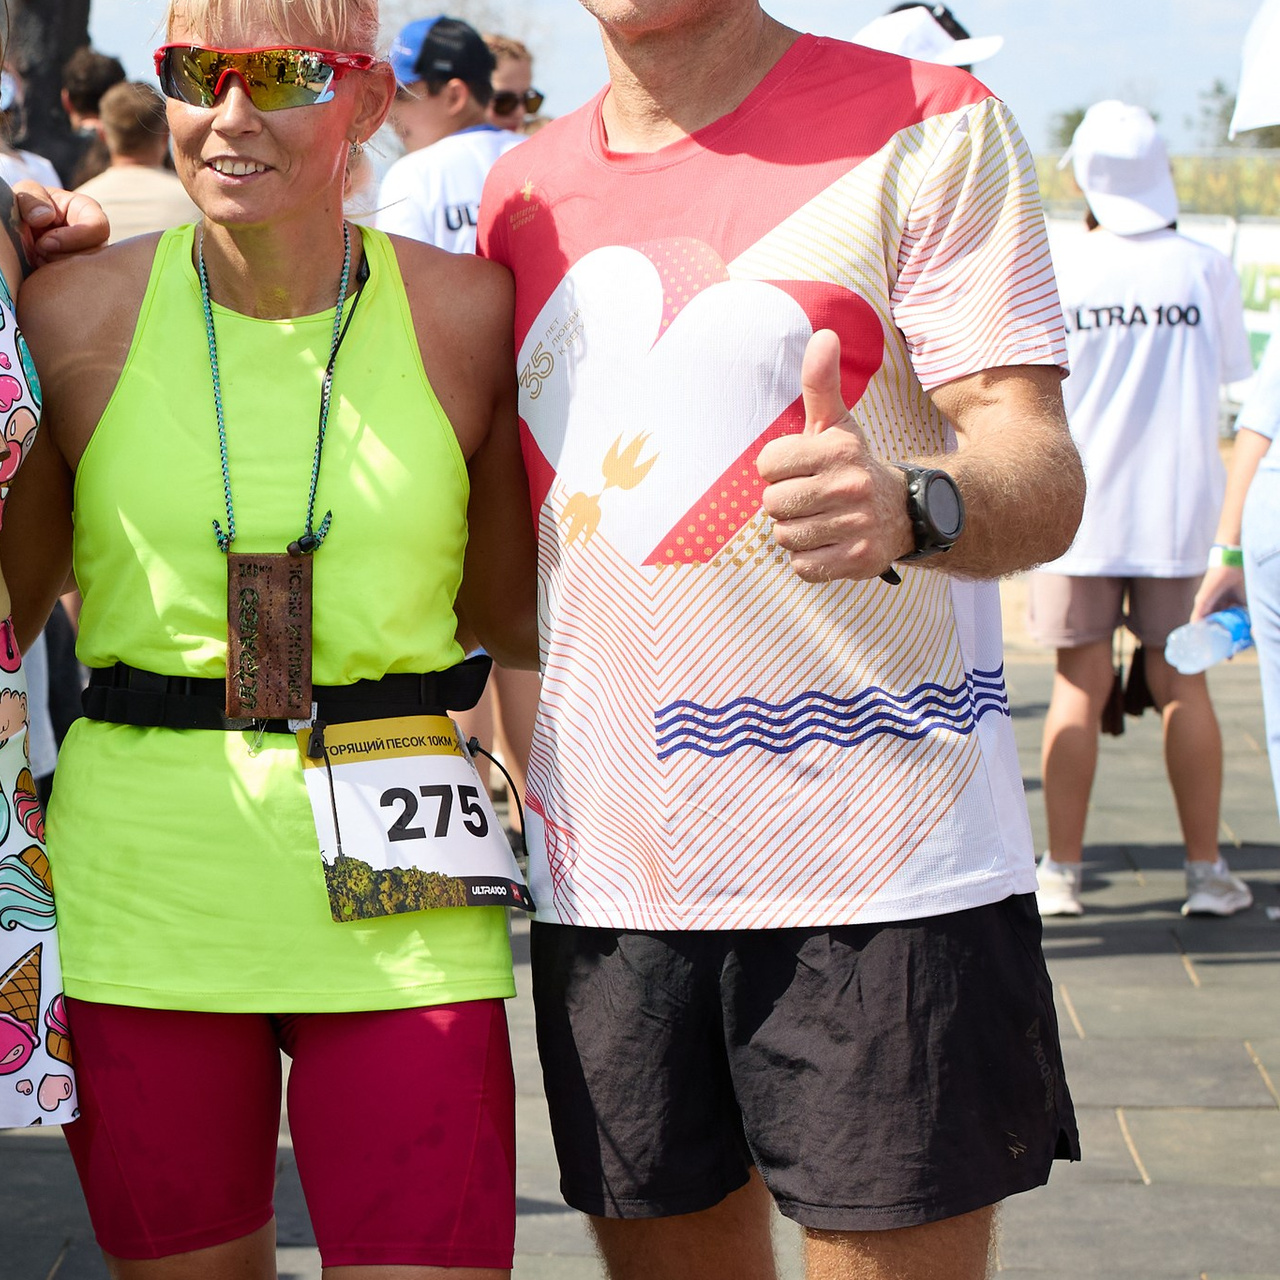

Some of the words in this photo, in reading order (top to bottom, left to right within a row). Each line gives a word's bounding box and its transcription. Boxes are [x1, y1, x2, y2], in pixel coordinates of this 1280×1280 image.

[445, 204, 480, 231] UL
[545, 317, 560, 339] ЛЕТ
[551, 307, 582, 347] ЛЮБВИ
[1065, 305, 1148, 334] LTRA
[1154, 304, 1201, 327] 100
[564, 321, 585, 348] БЕГУ
[519, 341, 555, 400] 35
[386, 736, 427, 749] ПЕСОК
[427, 735, 453, 748] 10КМ
[380, 784, 489, 842] 275
